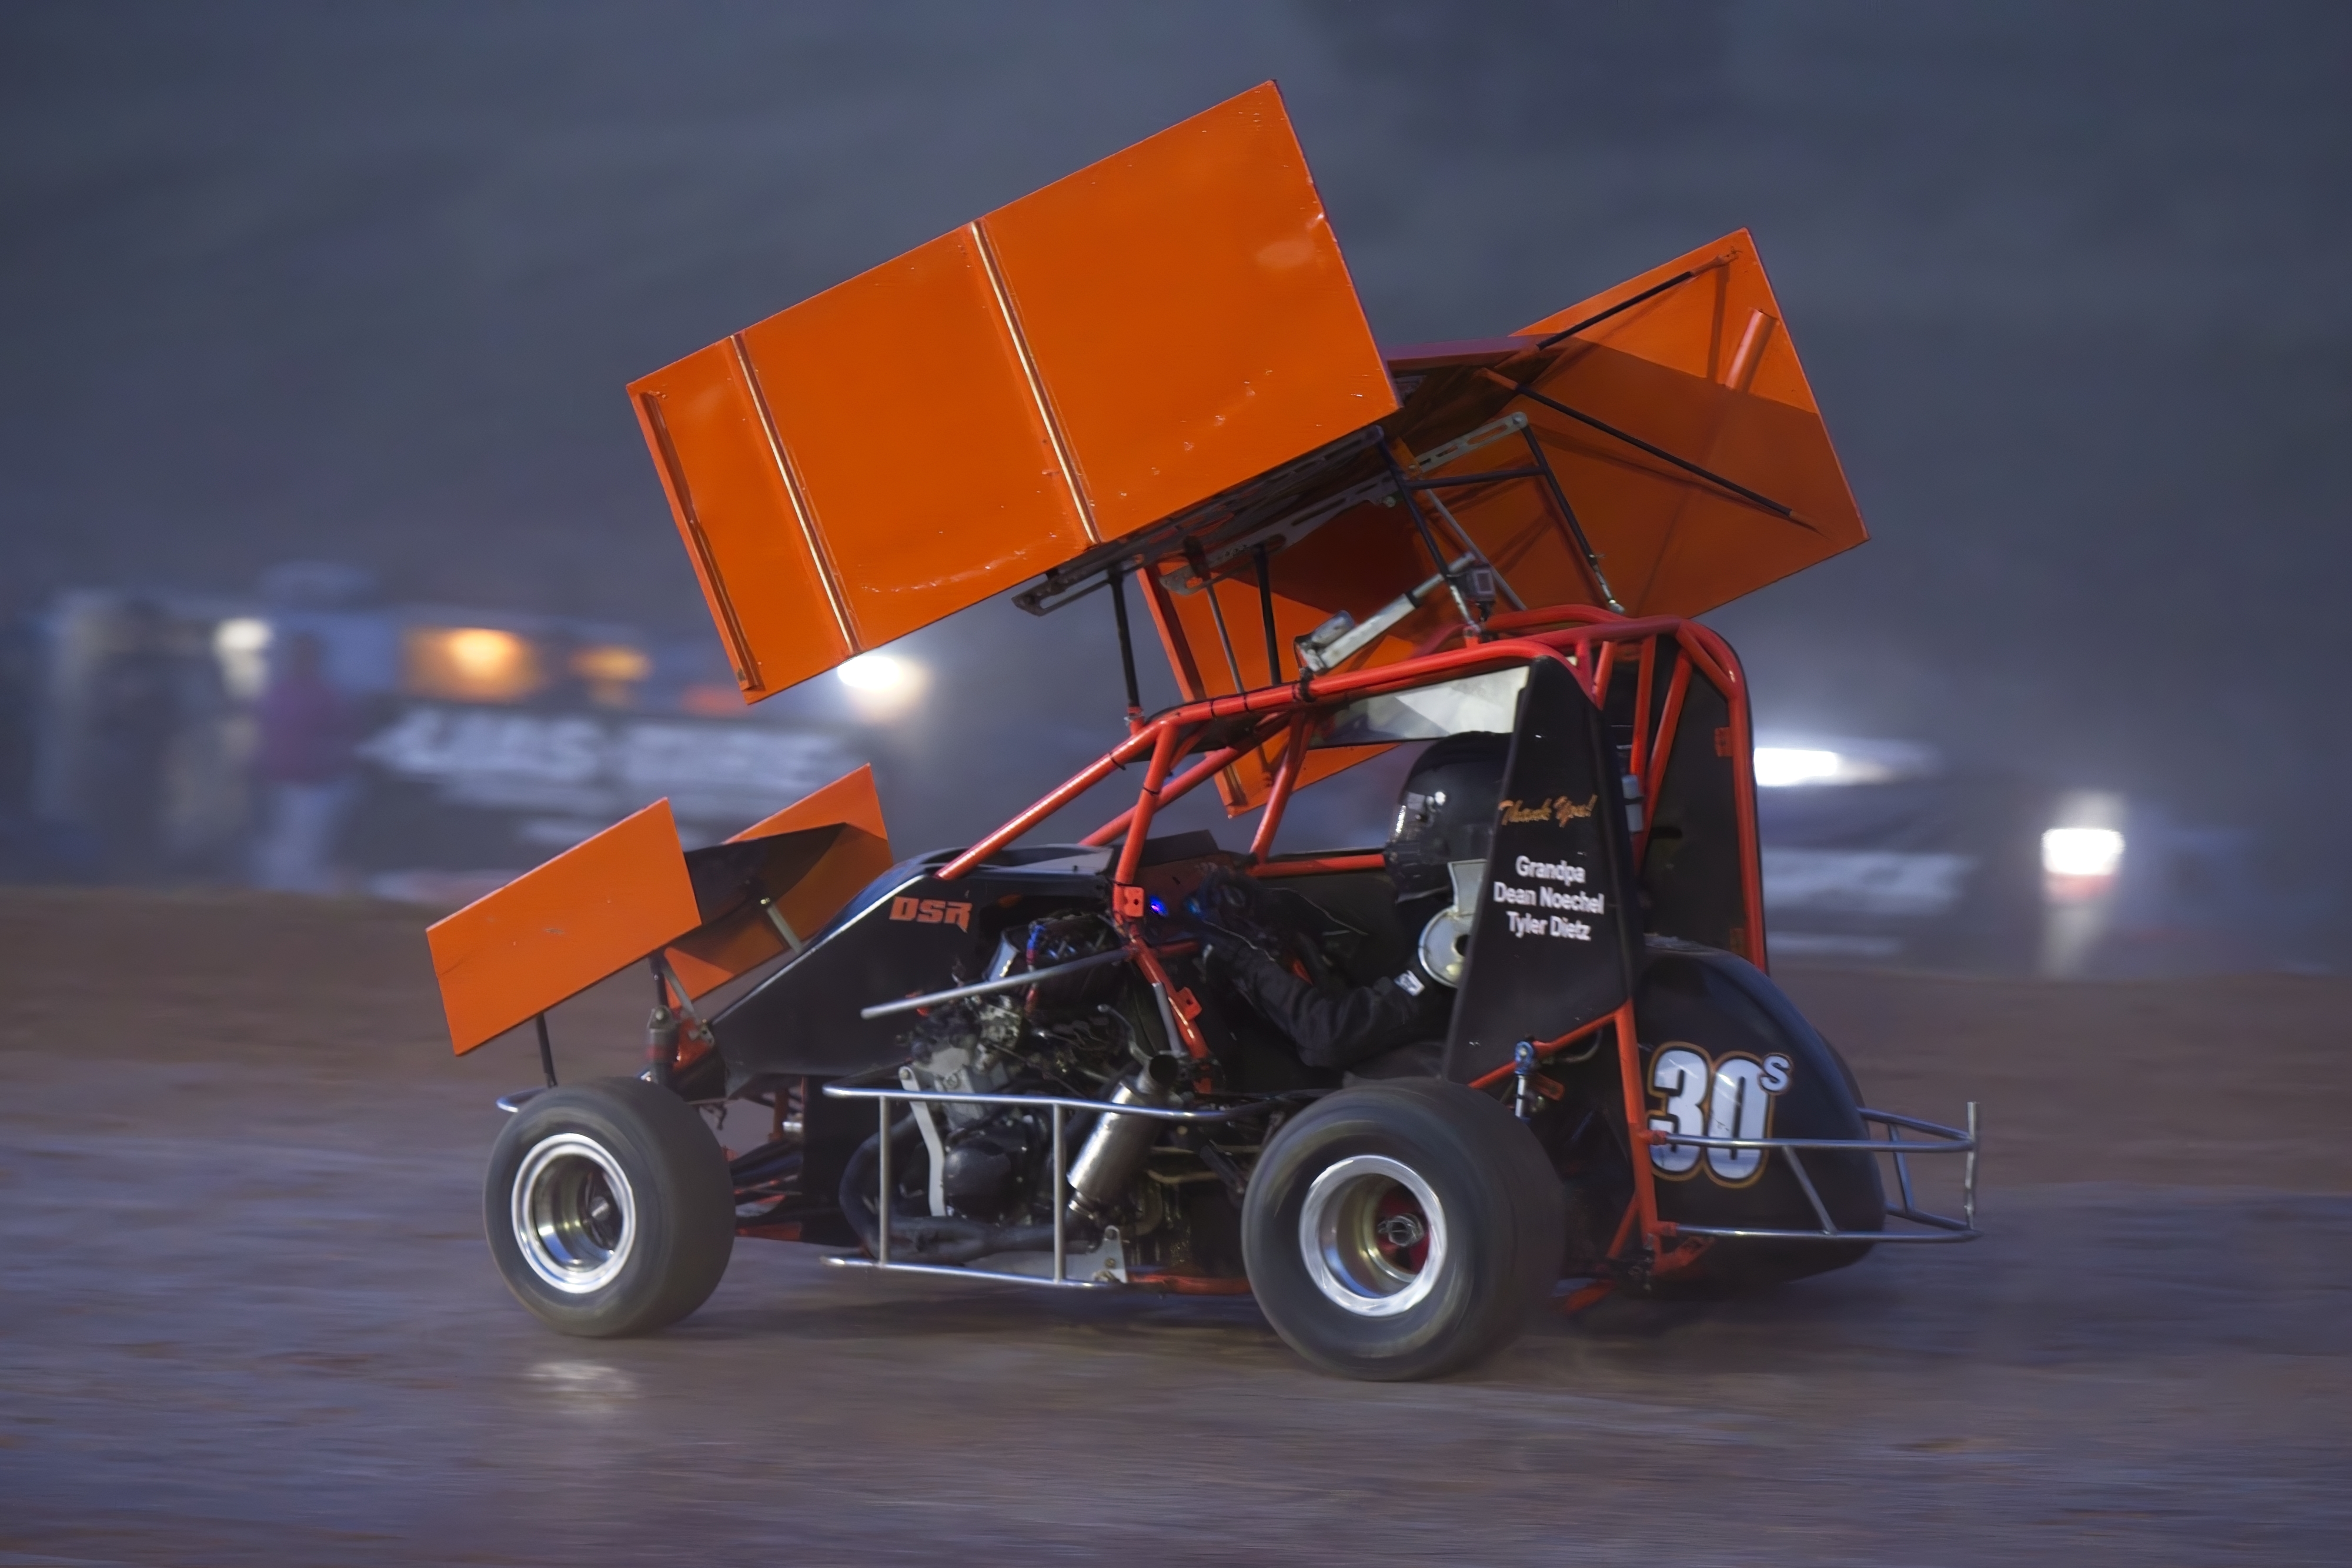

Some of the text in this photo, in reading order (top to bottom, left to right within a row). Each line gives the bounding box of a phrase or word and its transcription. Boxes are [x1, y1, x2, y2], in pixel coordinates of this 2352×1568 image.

[1515, 855, 1586, 887] Grandpa
[1494, 881, 1536, 906] Dean
[889, 896, 972, 933] DSR
[1506, 911, 1591, 941] Tyler Dietz
